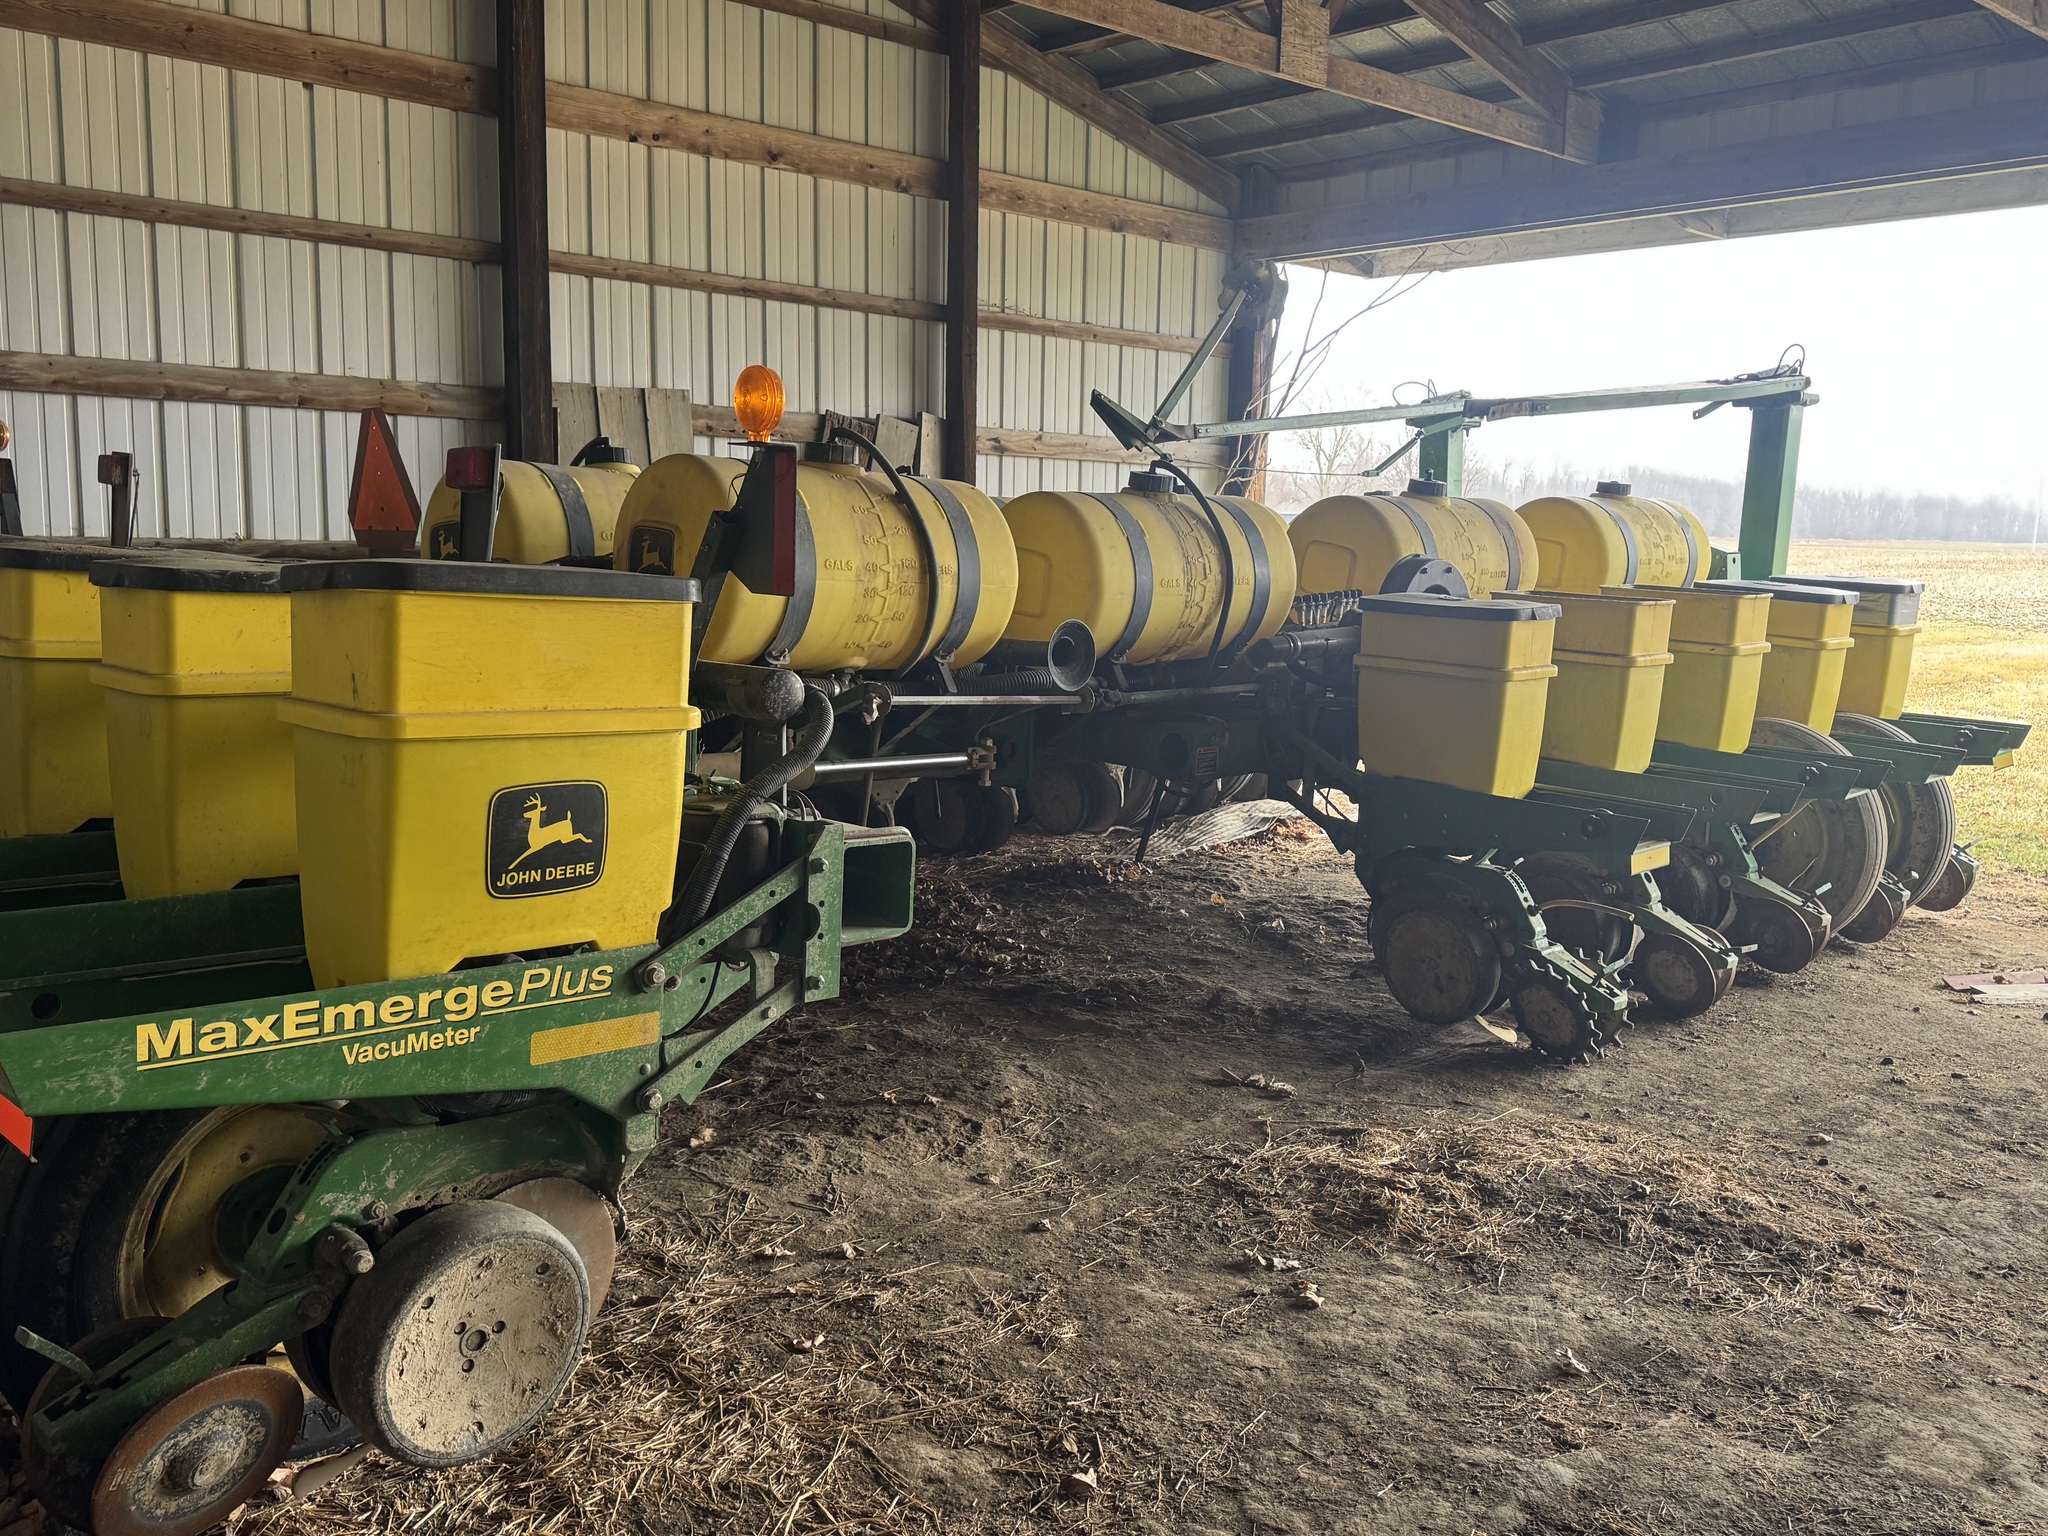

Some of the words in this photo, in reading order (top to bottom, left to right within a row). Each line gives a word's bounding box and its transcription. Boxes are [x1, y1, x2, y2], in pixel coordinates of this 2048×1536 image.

[852, 504, 867, 515] 60
[862, 535, 878, 545] 50
[824, 558, 855, 571] GALS
[865, 562, 879, 572] 40
[899, 558, 918, 569] 160
[1160, 577, 1182, 589] GALS
[863, 588, 878, 599] 30
[898, 585, 915, 596] 120
[855, 613, 871, 624] 20
[496, 869, 542, 888] JOHN
[545, 862, 595, 882] DEERE
[341, 1025, 482, 1066] VacuMeter
